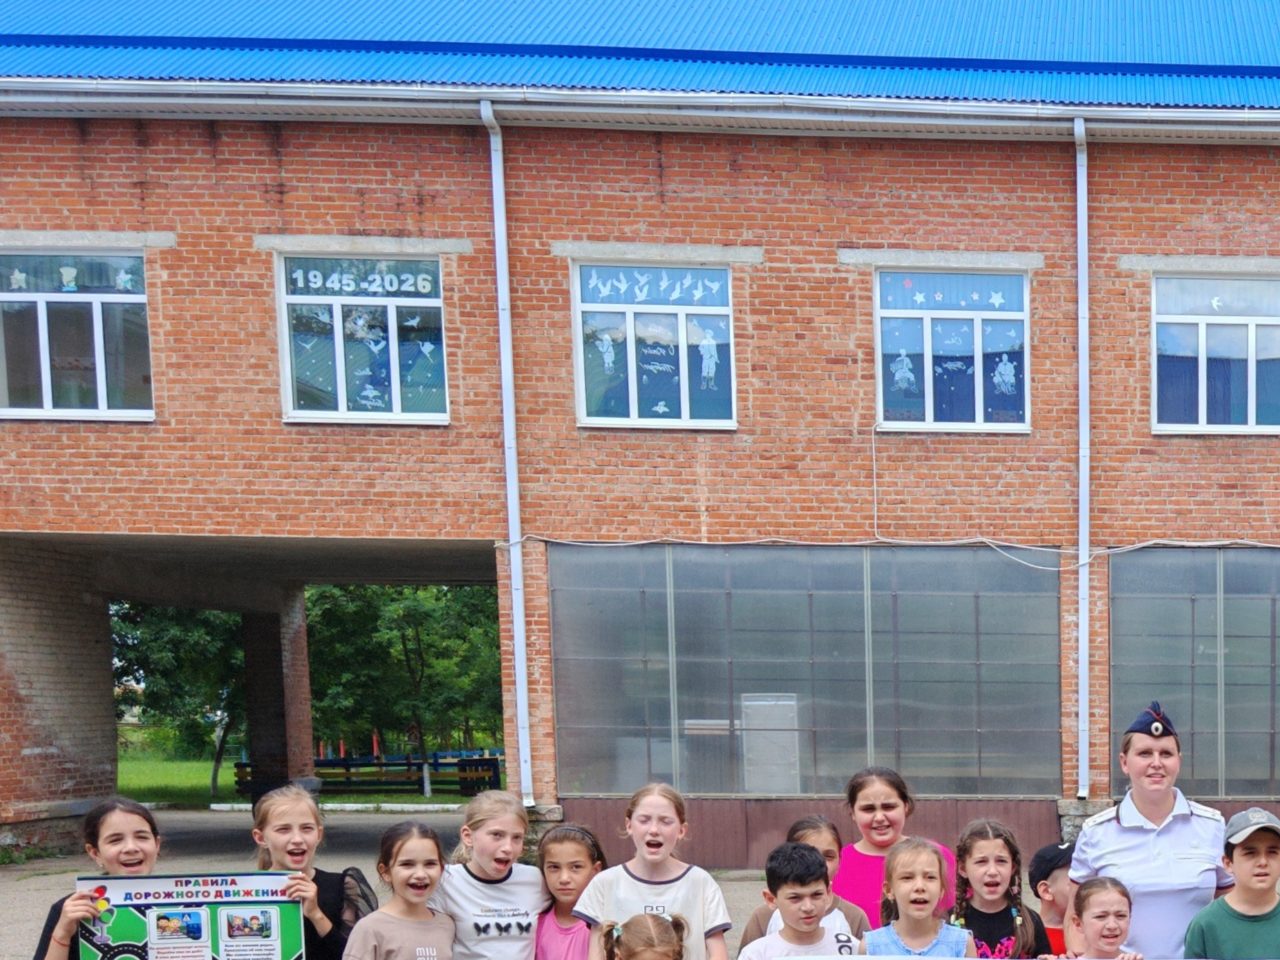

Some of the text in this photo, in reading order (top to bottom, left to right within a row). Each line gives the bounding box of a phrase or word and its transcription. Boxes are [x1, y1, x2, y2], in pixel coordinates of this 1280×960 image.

[292, 269, 432, 293] 1945-2026
[174, 878, 238, 888] ПРАВИЛА
[123, 889, 288, 902] ДОРОЖНОГО ДВИЖЕНИЯ
